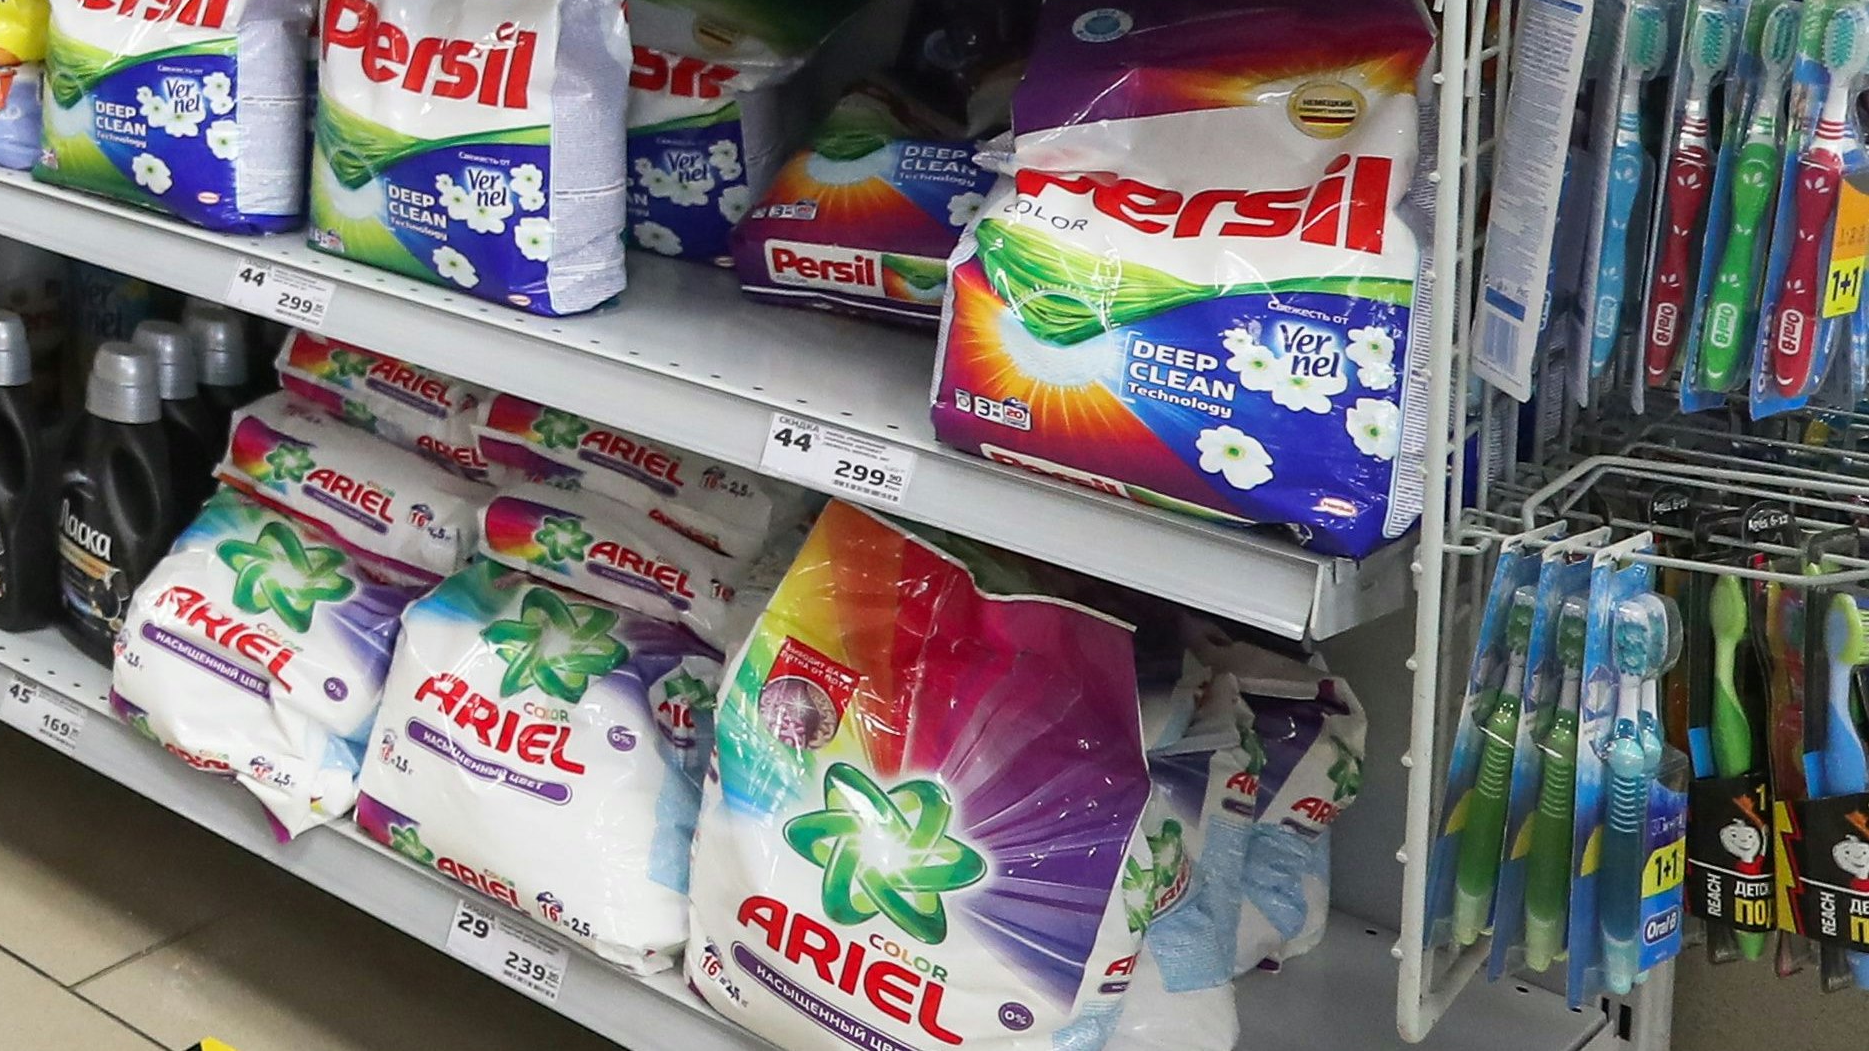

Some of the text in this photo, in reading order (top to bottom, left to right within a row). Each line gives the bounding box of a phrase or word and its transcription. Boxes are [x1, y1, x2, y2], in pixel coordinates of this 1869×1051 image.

[165, 79, 199, 101] Ver
[95, 100, 136, 120] DEEP
[173, 94, 202, 115] nel
[95, 116, 147, 137] CLEAN
[96, 131, 147, 149] Technology
[667, 152, 701, 171] Ver
[901, 157, 978, 176] CLEAN
[904, 146, 968, 160] DEEP
[468, 169, 502, 193] Ver
[678, 162, 709, 183] nel
[899, 169, 976, 187] Technology
[388, 185, 435, 208] DEEP
[476, 186, 507, 209] nel
[1015, 152, 1394, 255] Persil
[388, 202, 447, 229] CLEAN
[1003, 198, 1088, 232] COLOR
[390, 218, 448, 242] Technology
[239, 268, 266, 288] 44
[771, 249, 876, 287] Persil
[1832, 271, 1859, 301] 1+1
[278, 293, 313, 313] 299
[1268, 300, 1350, 325] Свежесть от
[1279, 323, 1333, 356] Ver
[1132, 340, 1219, 373] DEEP
[1289, 350, 1340, 379] nel
[369, 358, 452, 408] ARIEL
[1128, 362, 1236, 402] CLEAN
[976, 399, 989, 417] 3
[1127, 381, 1233, 419] Technology
[779, 416, 820, 433] СКИДКА
[581, 430, 685, 487] ARIEL
[834, 460, 886, 486] 299
[307, 467, 395, 524] ARIEL
[59, 498, 111, 559] Ласка
[587, 540, 695, 600] ARIEL
[155, 585, 294, 695] ARIEL
[155, 632, 239, 680] НАСЫЩЕННЫЙ
[8, 683, 32, 704] 45
[41, 714, 71, 737] 169
[414, 671, 586, 776] ARIEL
[523, 701, 569, 723] COLOR
[507, 768, 545, 795] ЦВЕТ
[1654, 848, 1678, 887] 1+1
[437, 856, 532, 917] ARIEL
[1708, 872, 1722, 917] REACH
[457, 911, 489, 940] 29
[540, 902, 592, 939] 16 2,5
[1820, 891, 1836, 937] REACH
[505, 953, 546, 982] 239
[701, 951, 718, 978] 16
[736, 894, 964, 1046] ARIEL
[868, 933, 949, 983] COLOR
[756, 963, 868, 1041] НАСЫЩЕННЫЙ
[1004, 1009, 1028, 1025] 0%
